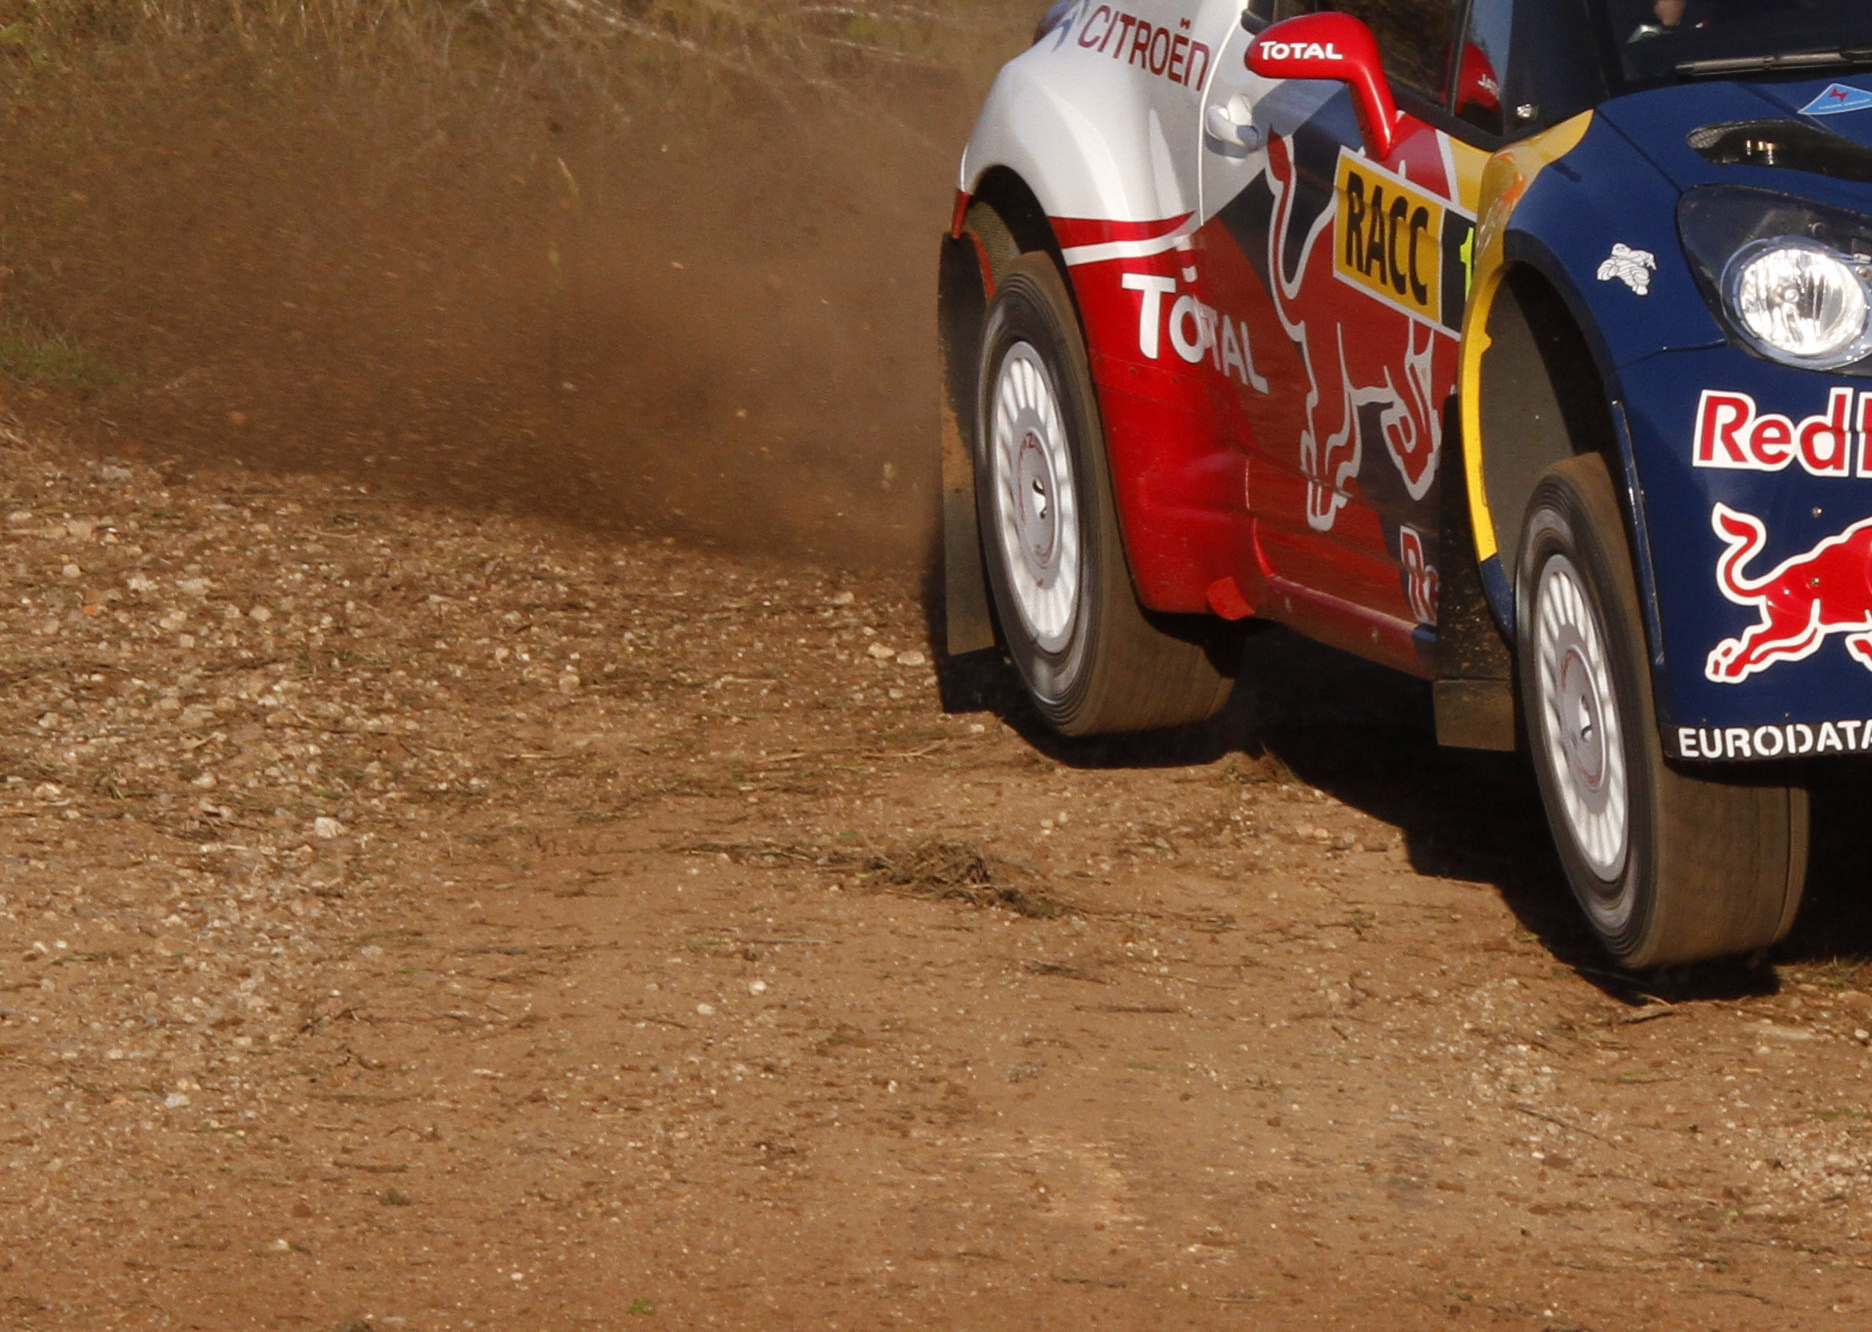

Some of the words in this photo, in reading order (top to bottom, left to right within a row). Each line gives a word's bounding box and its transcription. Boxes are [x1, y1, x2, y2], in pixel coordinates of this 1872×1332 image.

[1259, 40, 1343, 60] TOTAL
[1345, 170, 1429, 306] RACC
[1121, 272, 1269, 395] TOTAL
